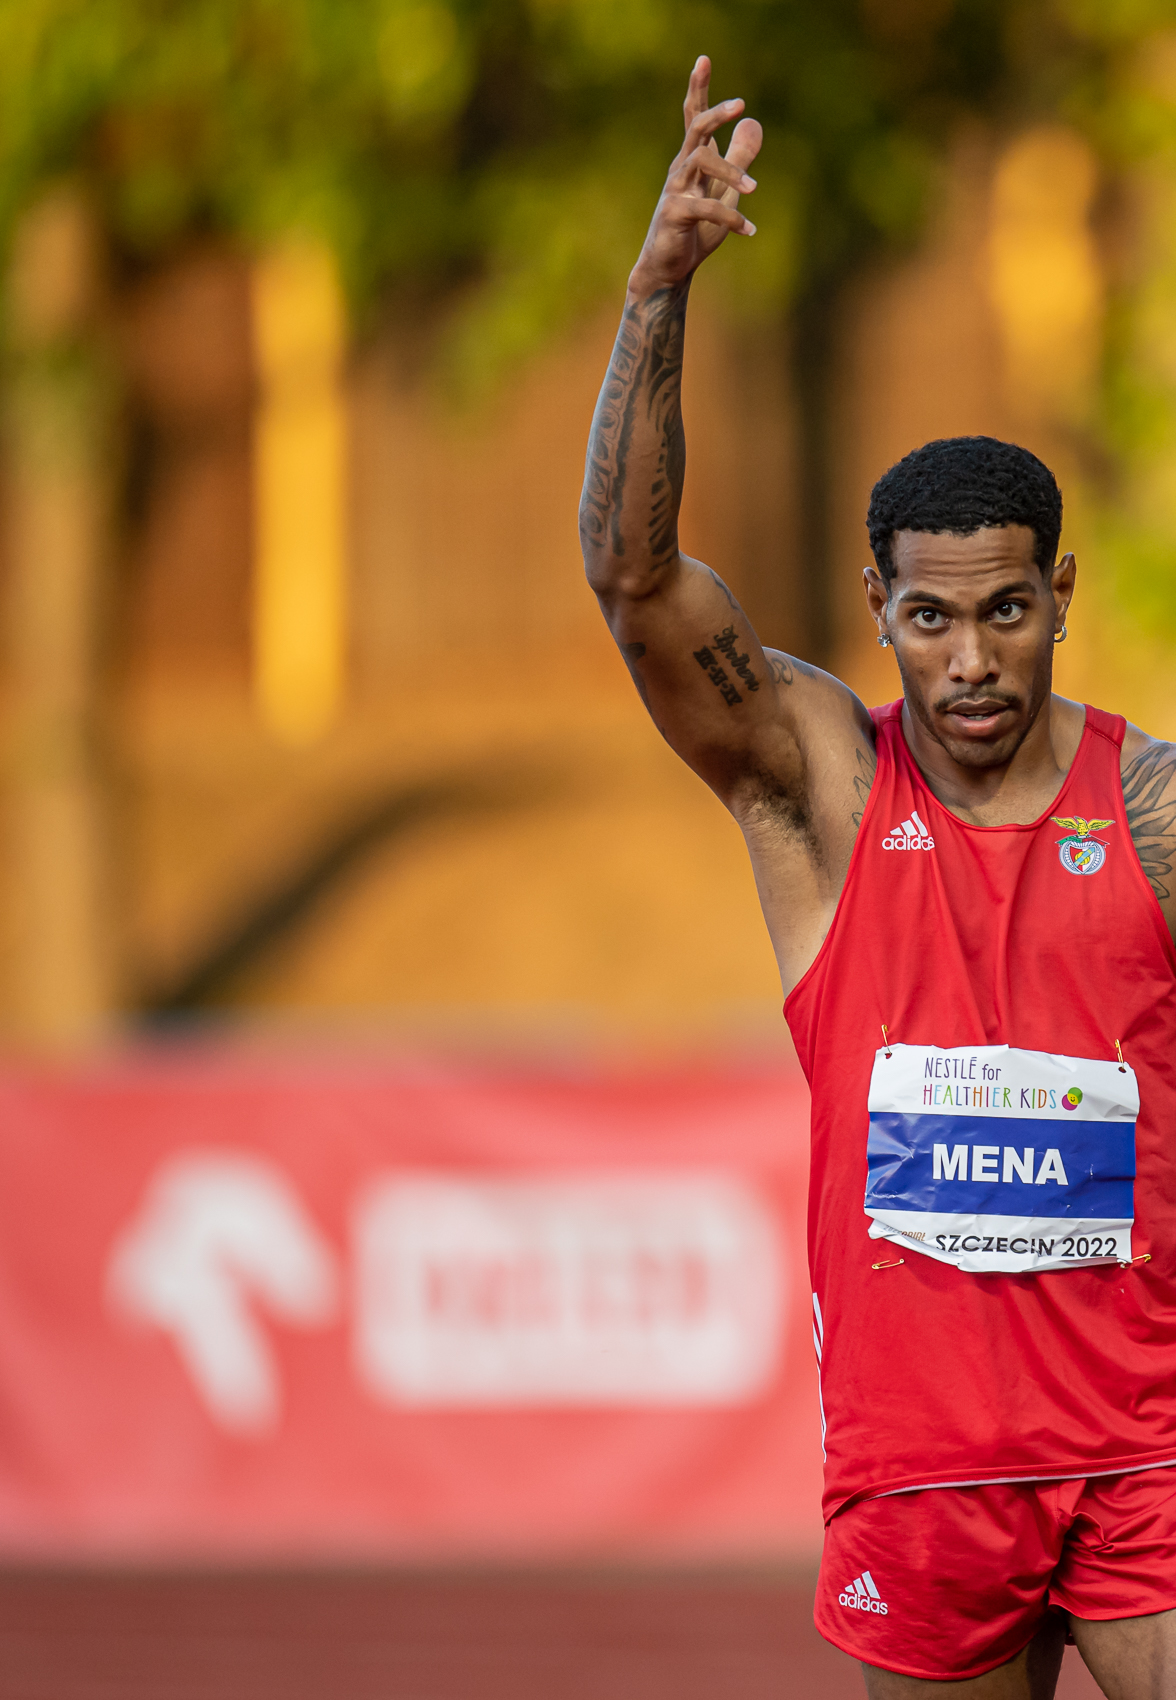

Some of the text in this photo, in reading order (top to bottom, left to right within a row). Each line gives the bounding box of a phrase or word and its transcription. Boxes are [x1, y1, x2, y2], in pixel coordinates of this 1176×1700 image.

[881, 834, 935, 851] adidas
[981, 1063, 1002, 1081] for
[923, 1083, 1057, 1110] HEALTHIER KIDS
[932, 1143, 1069, 1186] MENA
[935, 1234, 1118, 1258] SZCZECIN 2022
[838, 1593, 889, 1616] adidas
